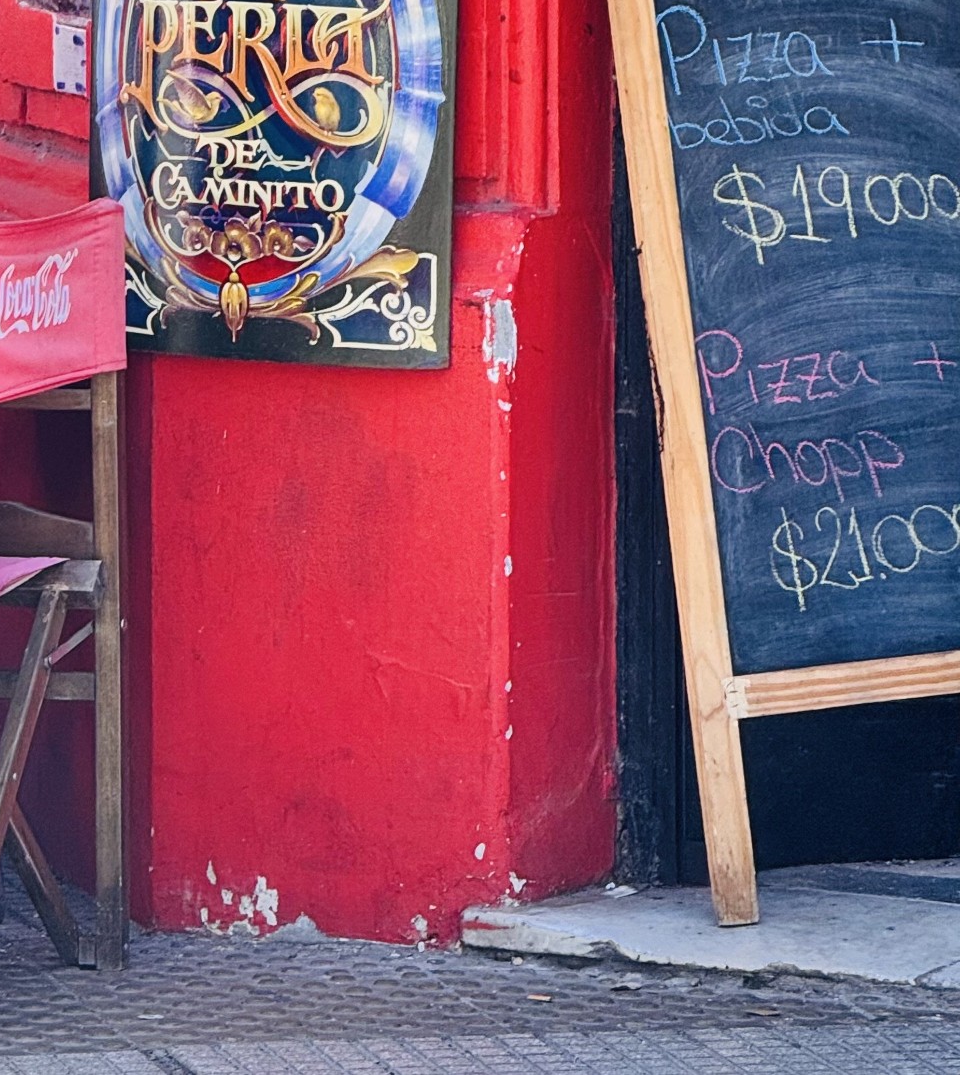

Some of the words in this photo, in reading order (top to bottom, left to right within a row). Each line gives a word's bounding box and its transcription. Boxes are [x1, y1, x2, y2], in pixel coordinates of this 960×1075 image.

[656, 5, 836, 95] Pizza
[152, 161, 346, 213] CAMINITO
[197, 135, 266, 171] DE
[695, 329, 879, 416] Pizza
[711, 423, 905, 502] Chopp
[772, 504, 960, 612] $21.00
